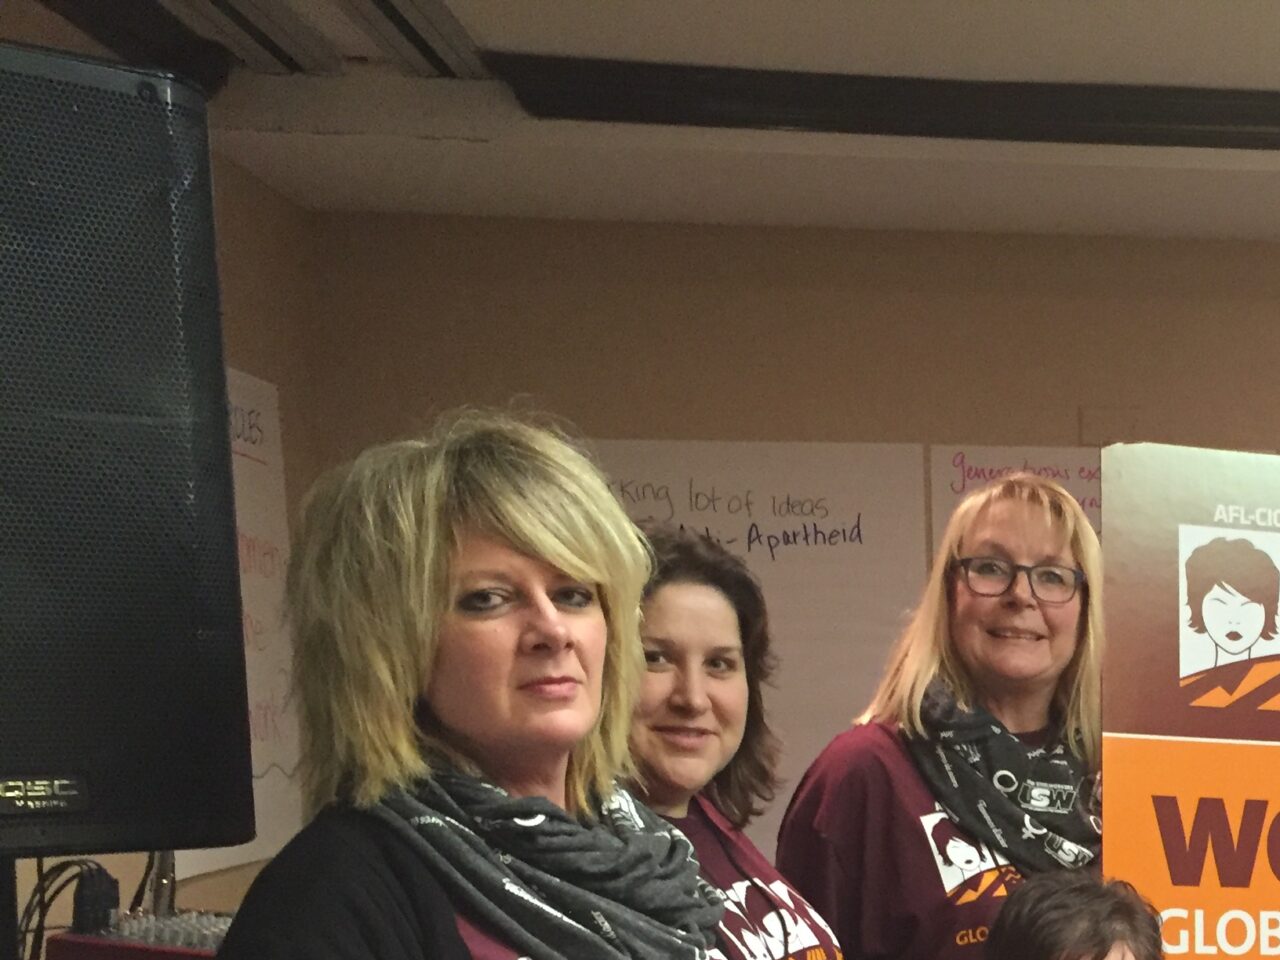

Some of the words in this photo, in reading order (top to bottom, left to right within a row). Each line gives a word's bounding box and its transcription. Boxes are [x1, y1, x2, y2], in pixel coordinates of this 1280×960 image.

[688, 477, 722, 514] lot
[727, 489, 754, 519] of
[0, 780, 79, 798] QSC
